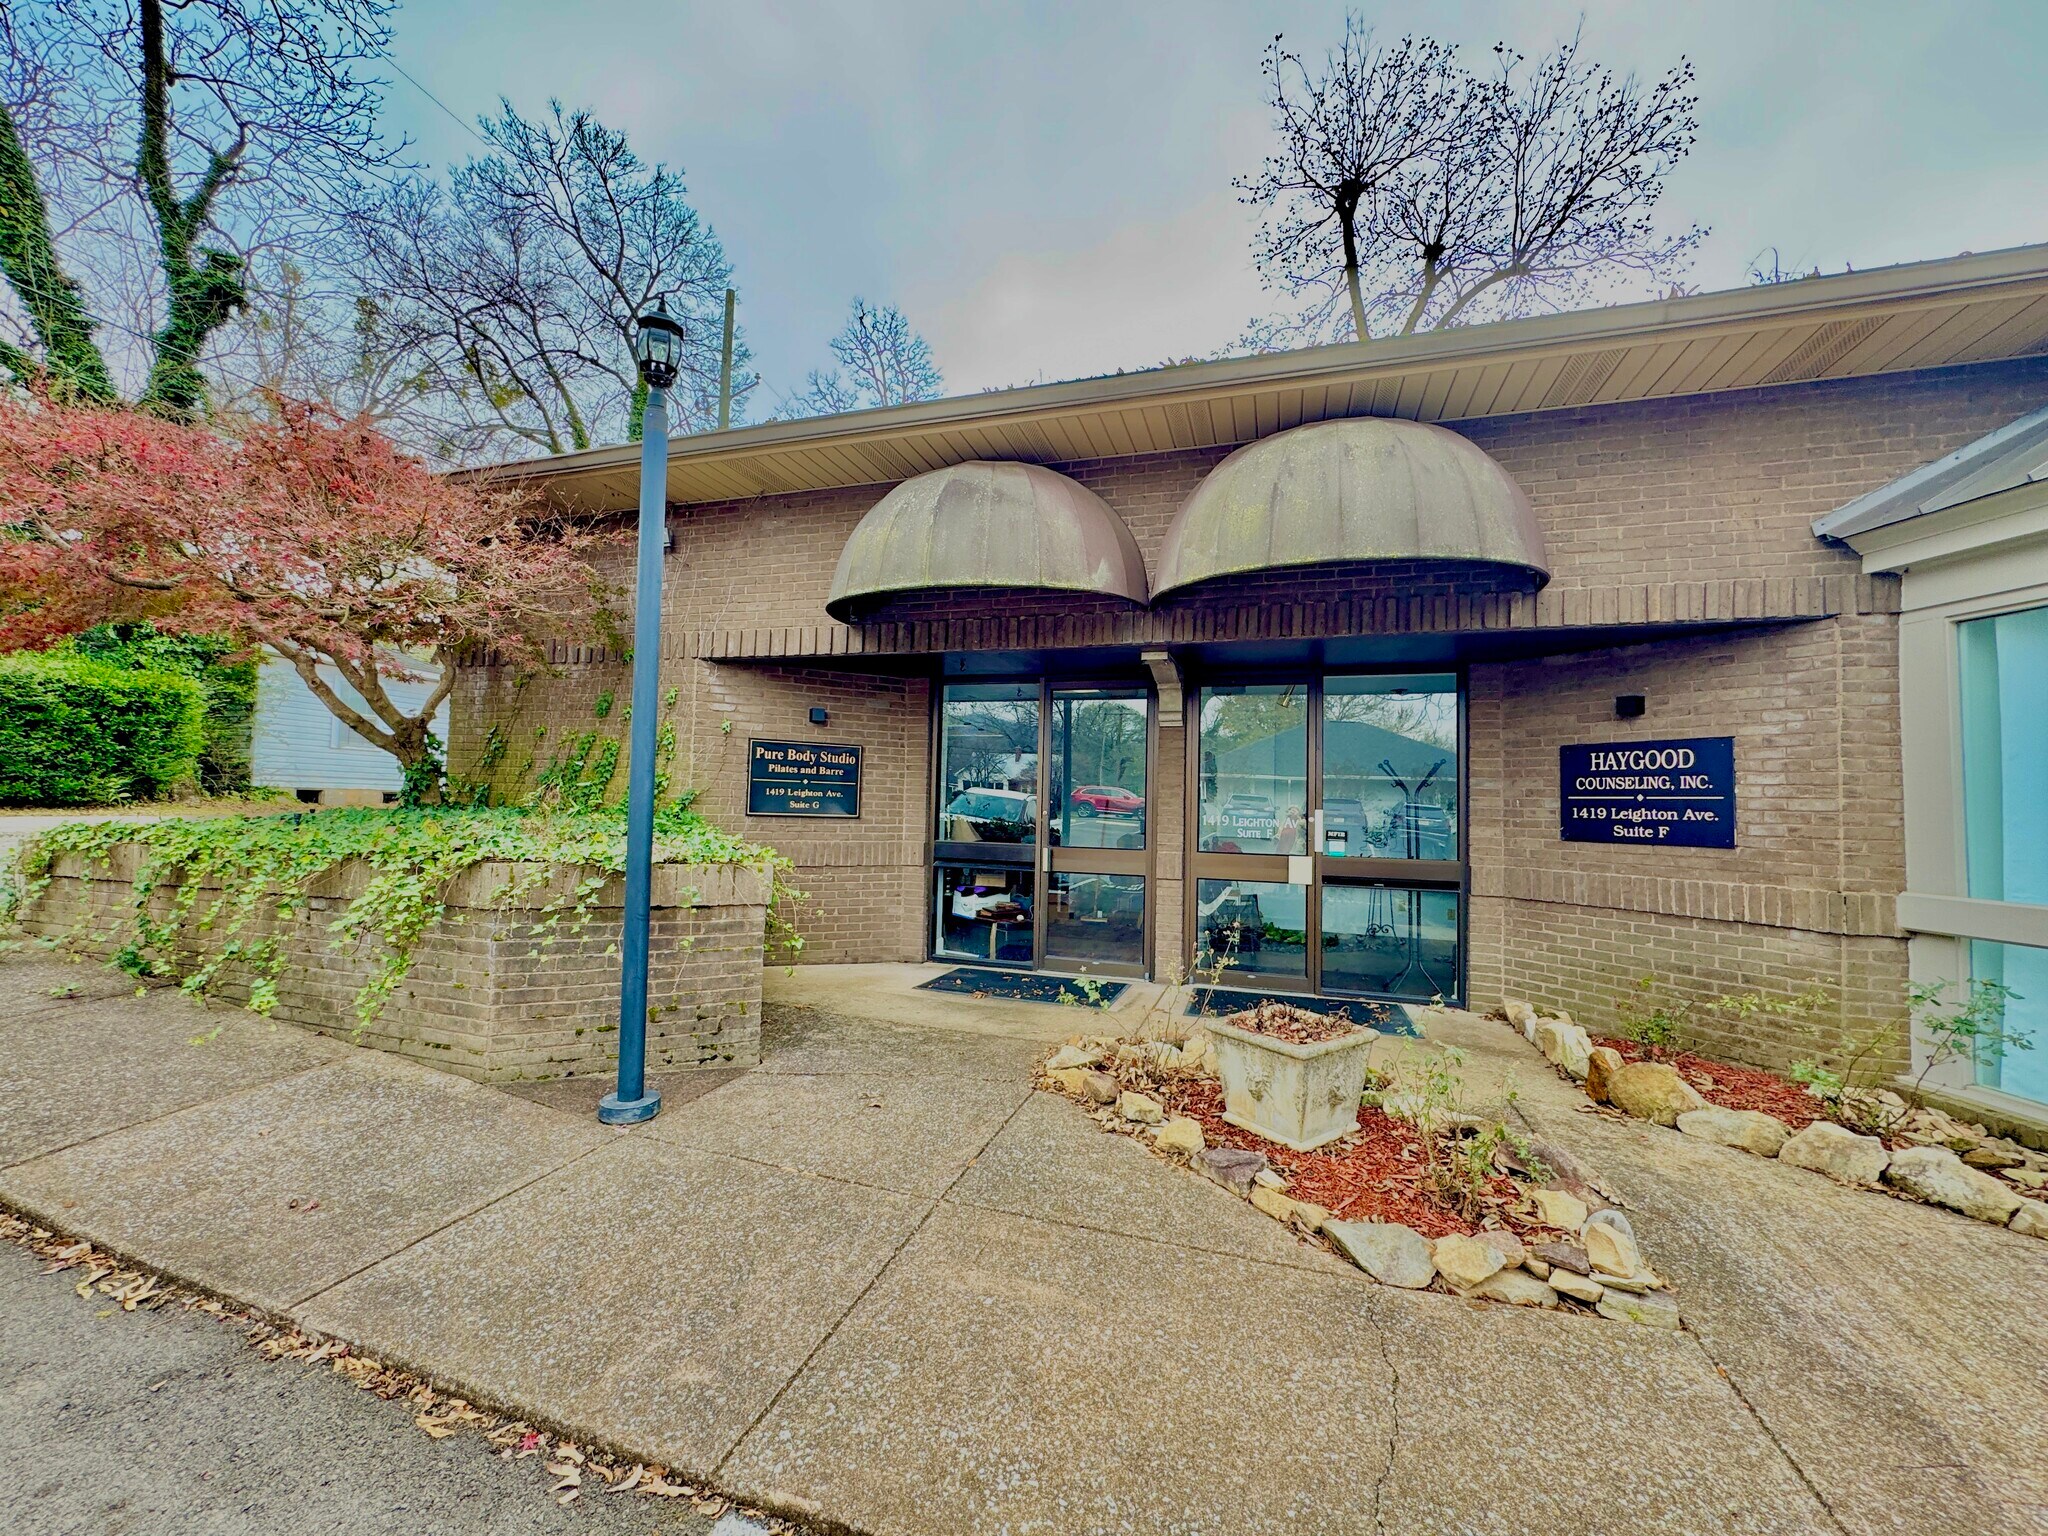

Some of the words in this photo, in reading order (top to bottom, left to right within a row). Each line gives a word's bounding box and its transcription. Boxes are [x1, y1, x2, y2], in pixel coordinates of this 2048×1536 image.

[755, 747, 784, 760] Pure
[787, 749, 817, 765] Body
[820, 751, 856, 764] Studio
[1590, 749, 1695, 771] HAYGOOD
[768, 764, 798, 773] Pilates
[800, 767, 817, 775] and
[819, 767, 844, 775] Barre
[1576, 776, 1675, 791] COUNSELING,
[1680, 775, 1713, 789] INC.
[766, 788, 785, 796] 1419
[788, 788, 823, 797] Leighton
[789, 801, 810, 809] Suite
[813, 801, 820, 809] G
[1202, 815, 1229, 826] 1419
[1573, 807, 1607, 820] 1419
[1611, 808, 1679, 822] Leighton
[1682, 808, 1719, 821] Ave.
[1266, 829, 1273, 838] F
[1613, 825, 1653, 837] Suite
[1659, 826, 1669, 838] F
